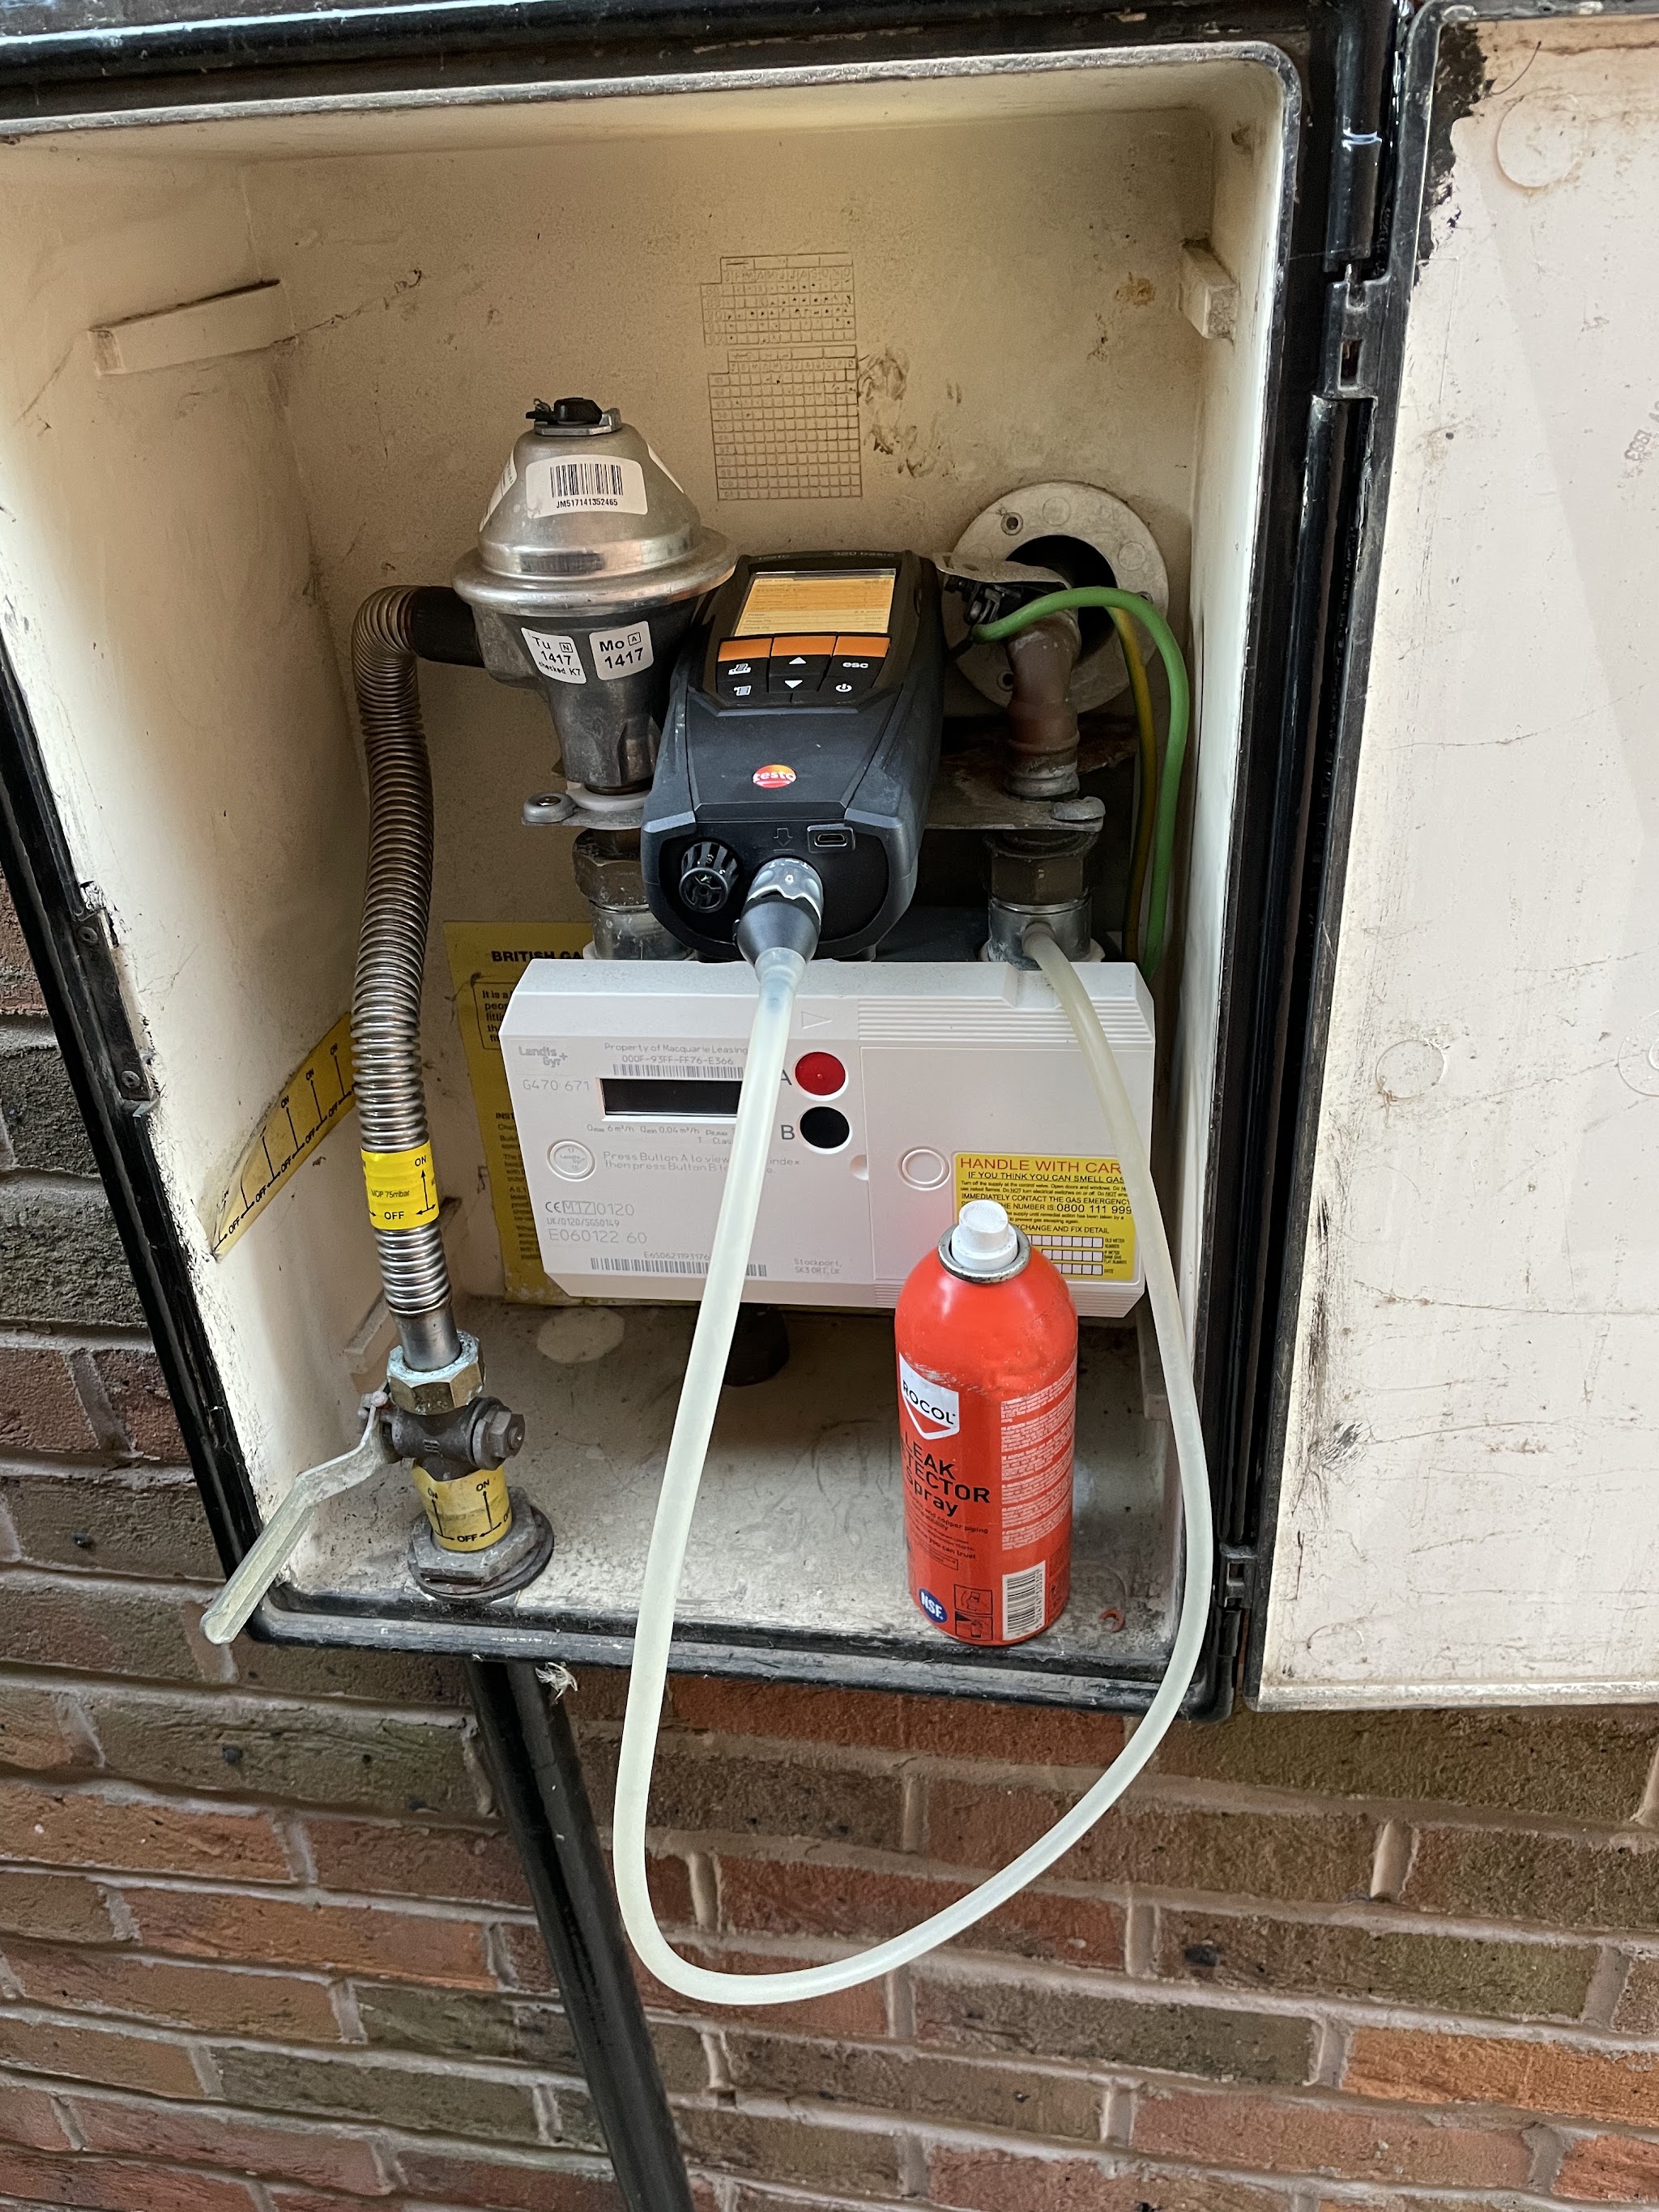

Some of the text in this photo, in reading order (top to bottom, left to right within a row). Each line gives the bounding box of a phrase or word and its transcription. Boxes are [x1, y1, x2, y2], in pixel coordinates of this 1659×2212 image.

[556, 498, 618, 509] JM517141352465
[532, 636, 552, 650] Tu
[599, 640, 625, 652] Mo
[540, 650, 571, 666] 1417
[604, 647, 644, 669] 1417
[569, 667, 581, 676] K7
[753, 771, 796, 782] testo
[491, 950, 584, 962] BRITISH GA
[518, 1045, 557, 1057] Landis
[604, 1042, 748, 1055] Property of Macquarie Leasing
[305, 1068, 314, 1081] ON
[780, 1069, 793, 1085] A
[522, 1079, 590, 1092] G470 671
[280, 1095, 290, 1109] ON
[328, 1102, 339, 1118] OFF
[305, 1127, 316, 1144] OFF
[781, 1124, 795, 1140] B
[713, 1137, 733, 1145] Clas
[415, 1155, 427, 1166] ON
[603, 1151, 638, 1161] Press
[640, 1152, 679, 1161] Button
[691, 1154, 702, 1163] to
[280, 1157, 292, 1174] OFF
[668, 1161, 707, 1171] Button
[709, 1163, 717, 1172] B
[961, 1157, 1122, 1174] HANDLE WITH CAR
[1000, 1172, 1027, 1180] THINK
[255, 1185, 267, 1203] OFF
[386, 1190, 410, 1198] 75mbar
[1083, 1197, 1130, 1205] EMERGENCY
[384, 1211, 404, 1220] OFF
[597, 1203, 634, 1216] 0120
[1056, 1204, 1085, 1213] 0800
[1089, 1204, 1107, 1214] 111
[1111, 1205, 1132, 1214] 999
[228, 1217, 241, 1235] OFF
[549, 1229, 647, 1244] E060122 60
[644, 1251, 711, 1261] E6S0621193176
[794, 1258, 842, 1268] Stockport,
[905, 1430, 957, 1481] LEAK
[476, 1479, 490, 1493] ON
[906, 1467, 958, 1518] Spray
[457, 1533, 478, 1543] OFF
[920, 1591, 943, 1618] NSF
